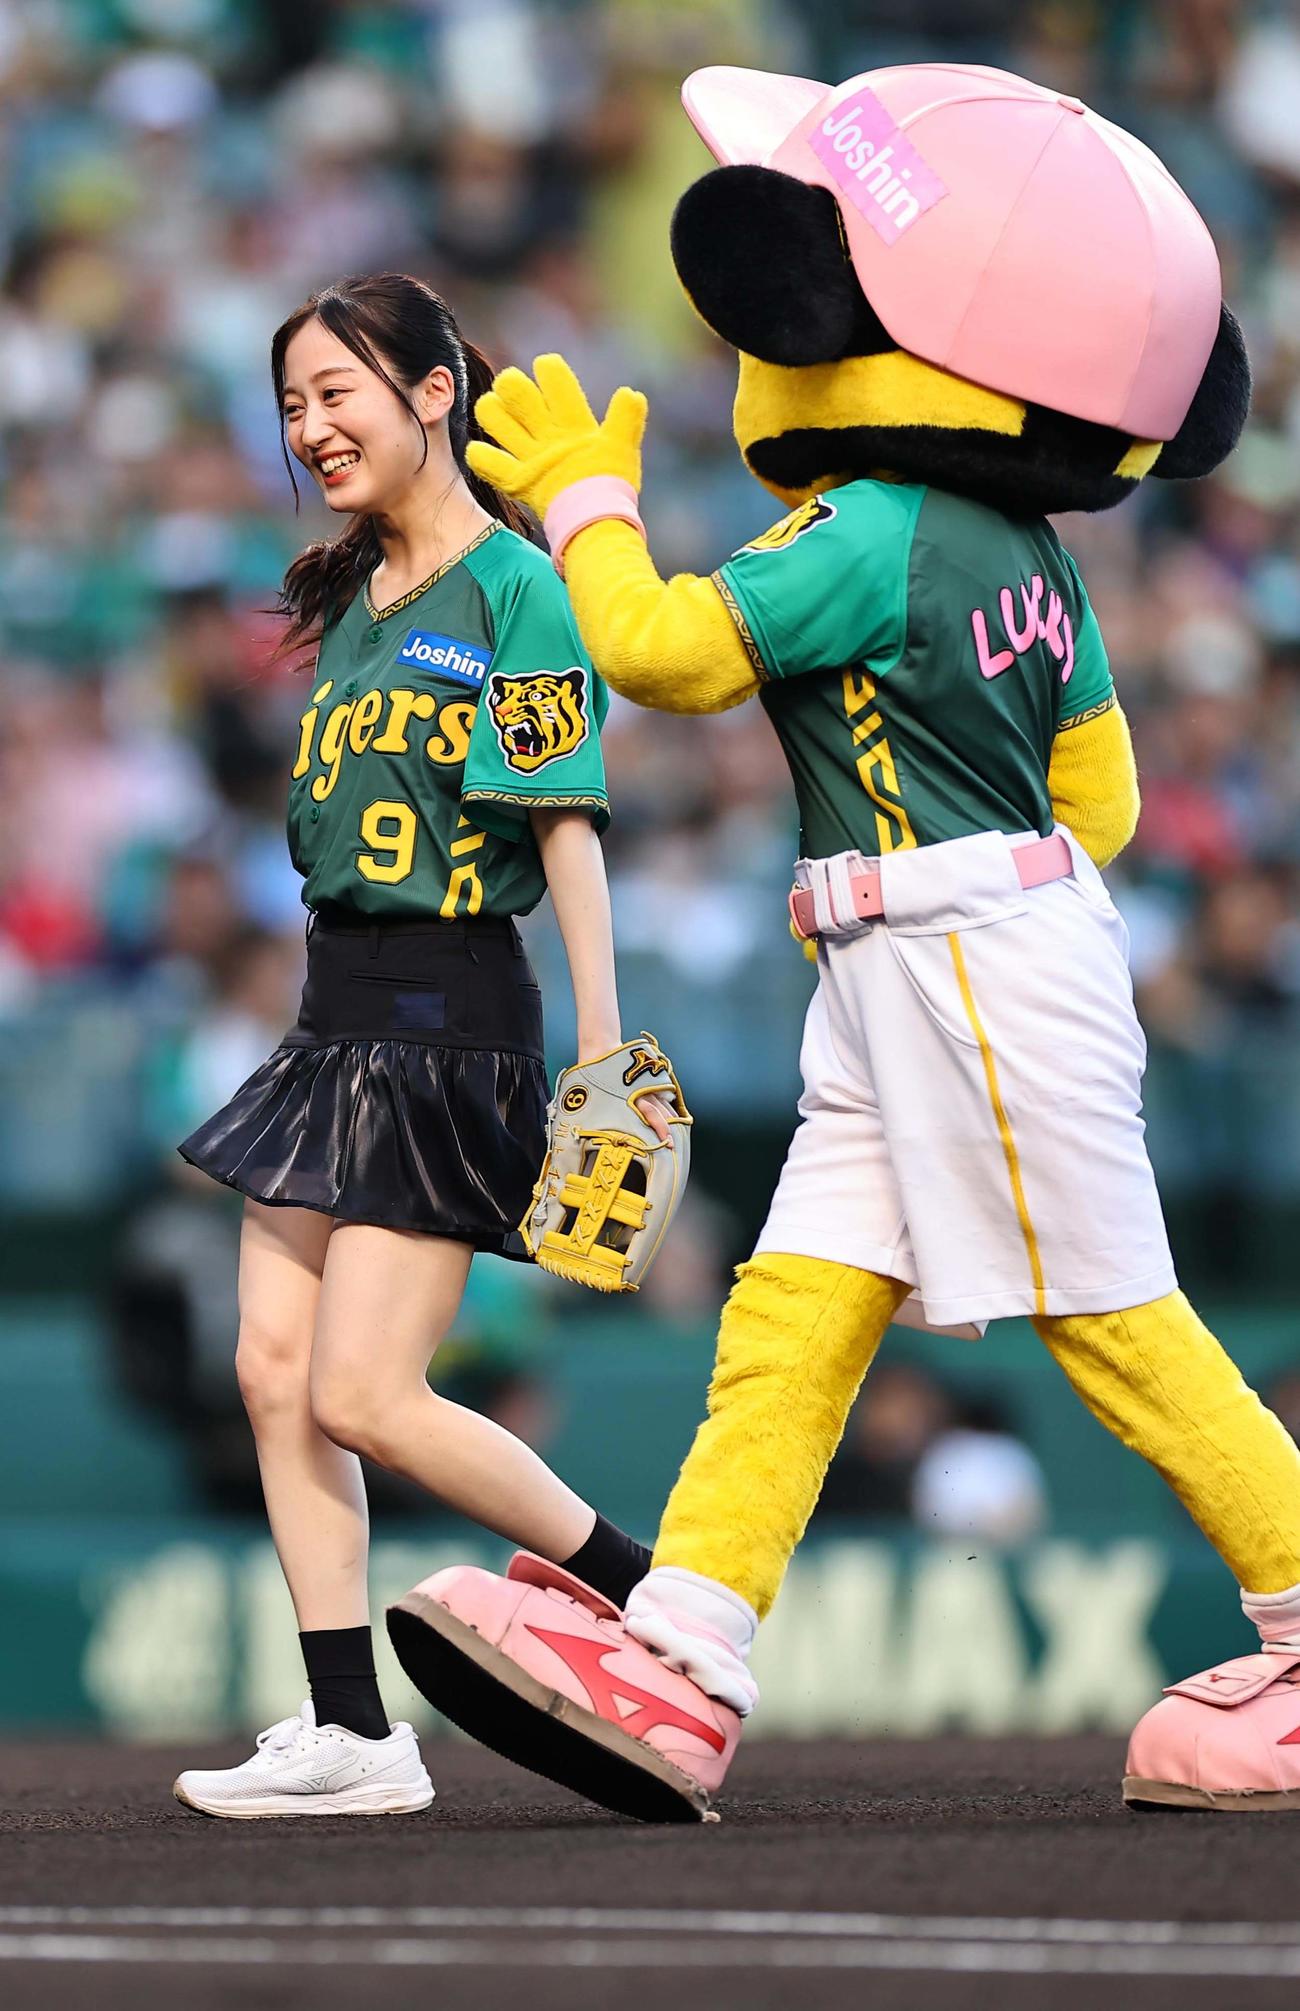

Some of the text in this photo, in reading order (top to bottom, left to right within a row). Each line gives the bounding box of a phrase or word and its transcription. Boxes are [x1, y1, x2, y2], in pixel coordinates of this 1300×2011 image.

[822, 106, 919, 228] Joshin
[402, 637, 486, 680] Joshin
[291, 679, 477, 803] igers
[354, 798, 418, 886] 9
